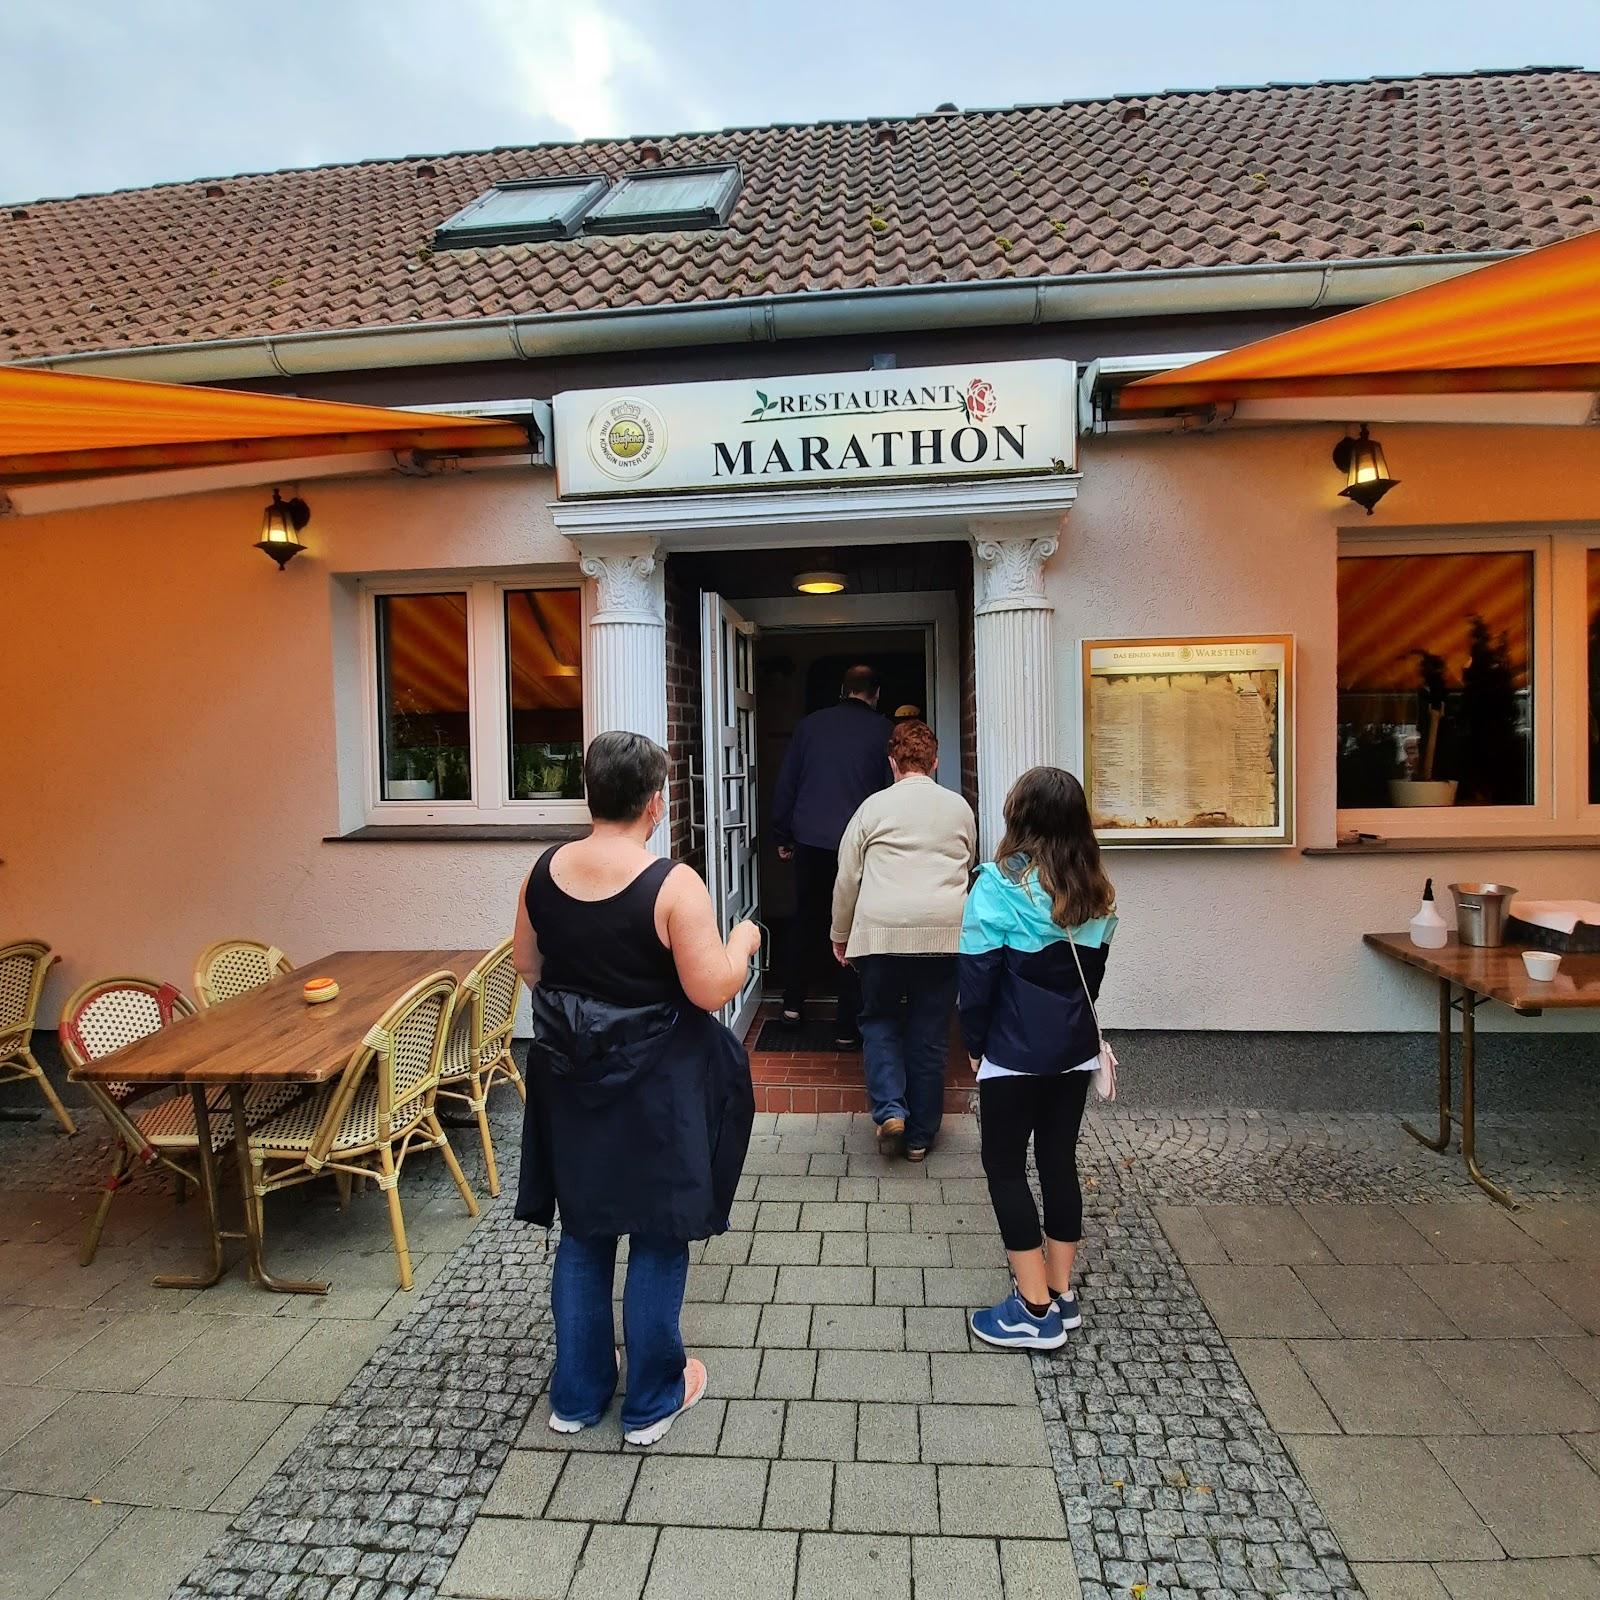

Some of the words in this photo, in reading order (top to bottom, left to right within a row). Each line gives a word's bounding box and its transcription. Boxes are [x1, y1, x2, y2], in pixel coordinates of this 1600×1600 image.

[779, 385, 955, 413] RESTAURANT
[600, 420, 611, 437] EINE
[618, 459, 642, 468] UNTER
[641, 445, 653, 460] DEN
[711, 424, 1028, 477] MARATHON
[1195, 648, 1258, 658] WARSTEINER
